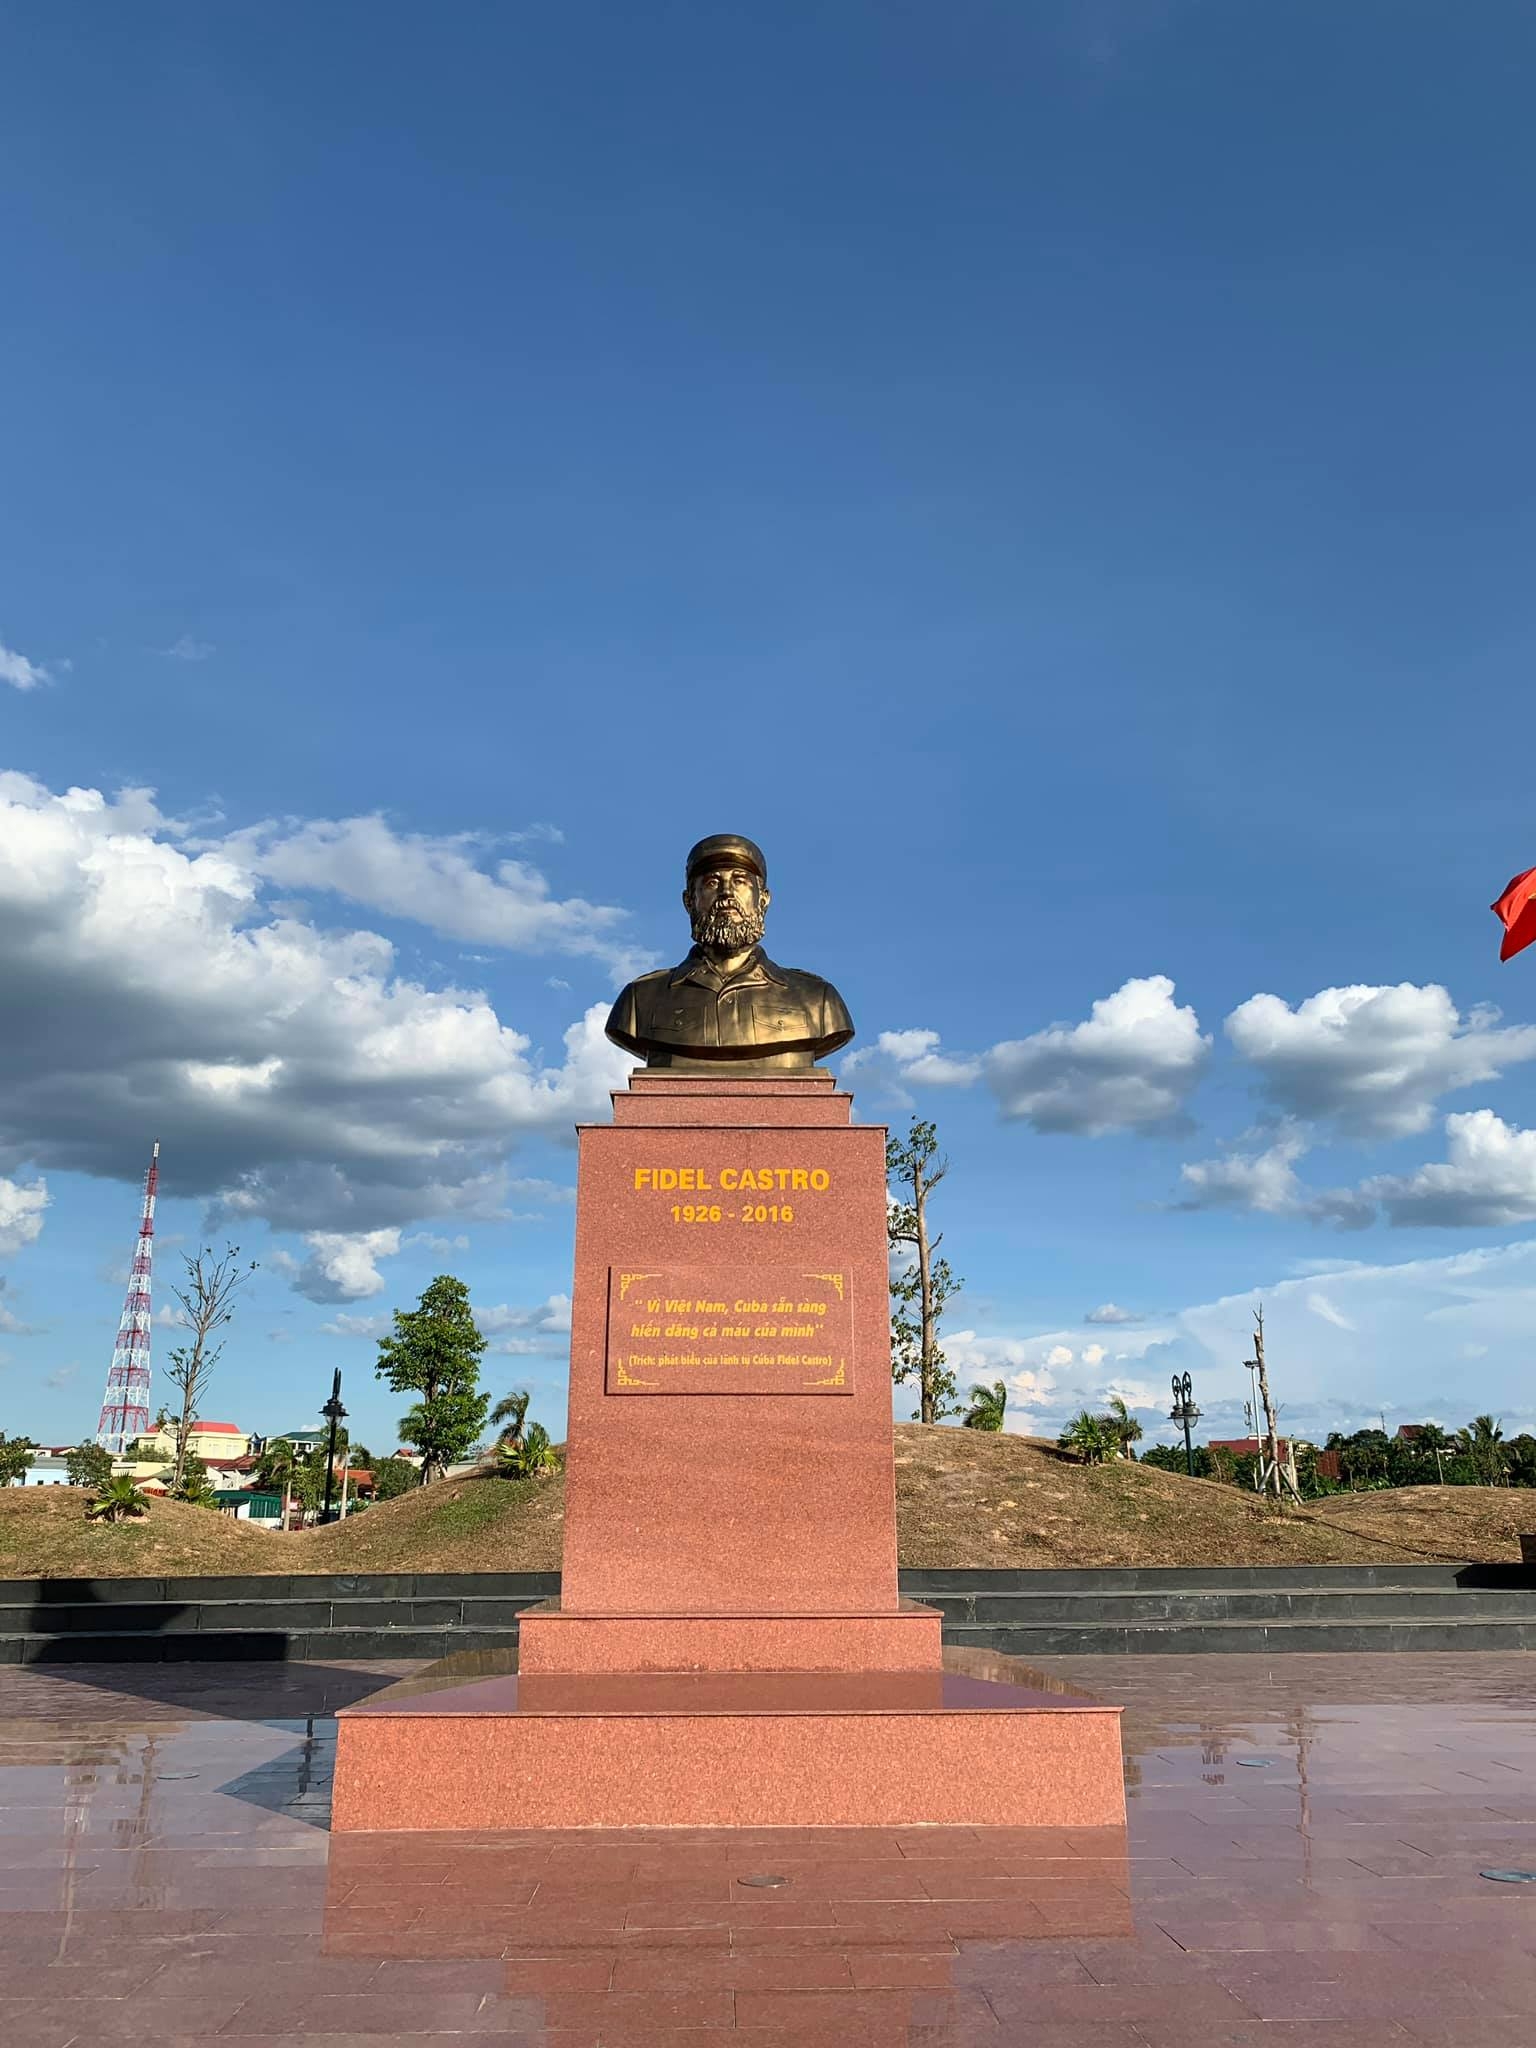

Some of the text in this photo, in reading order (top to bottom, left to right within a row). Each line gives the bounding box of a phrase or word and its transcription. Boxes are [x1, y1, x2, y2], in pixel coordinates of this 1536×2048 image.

[634, 1168, 830, 1191] FIDEL CASTRO
[670, 1205, 722, 1223] 1926
[741, 1205, 794, 1223] 2016
[665, 1299, 692, 1315] Việt
[695, 1299, 729, 1315] Nam,
[734, 1299, 768, 1313] Cuba
[797, 1297, 827, 1316] sàng
[721, 1321, 750, 1337] máu
[777, 1354, 800, 1365] Fidel
